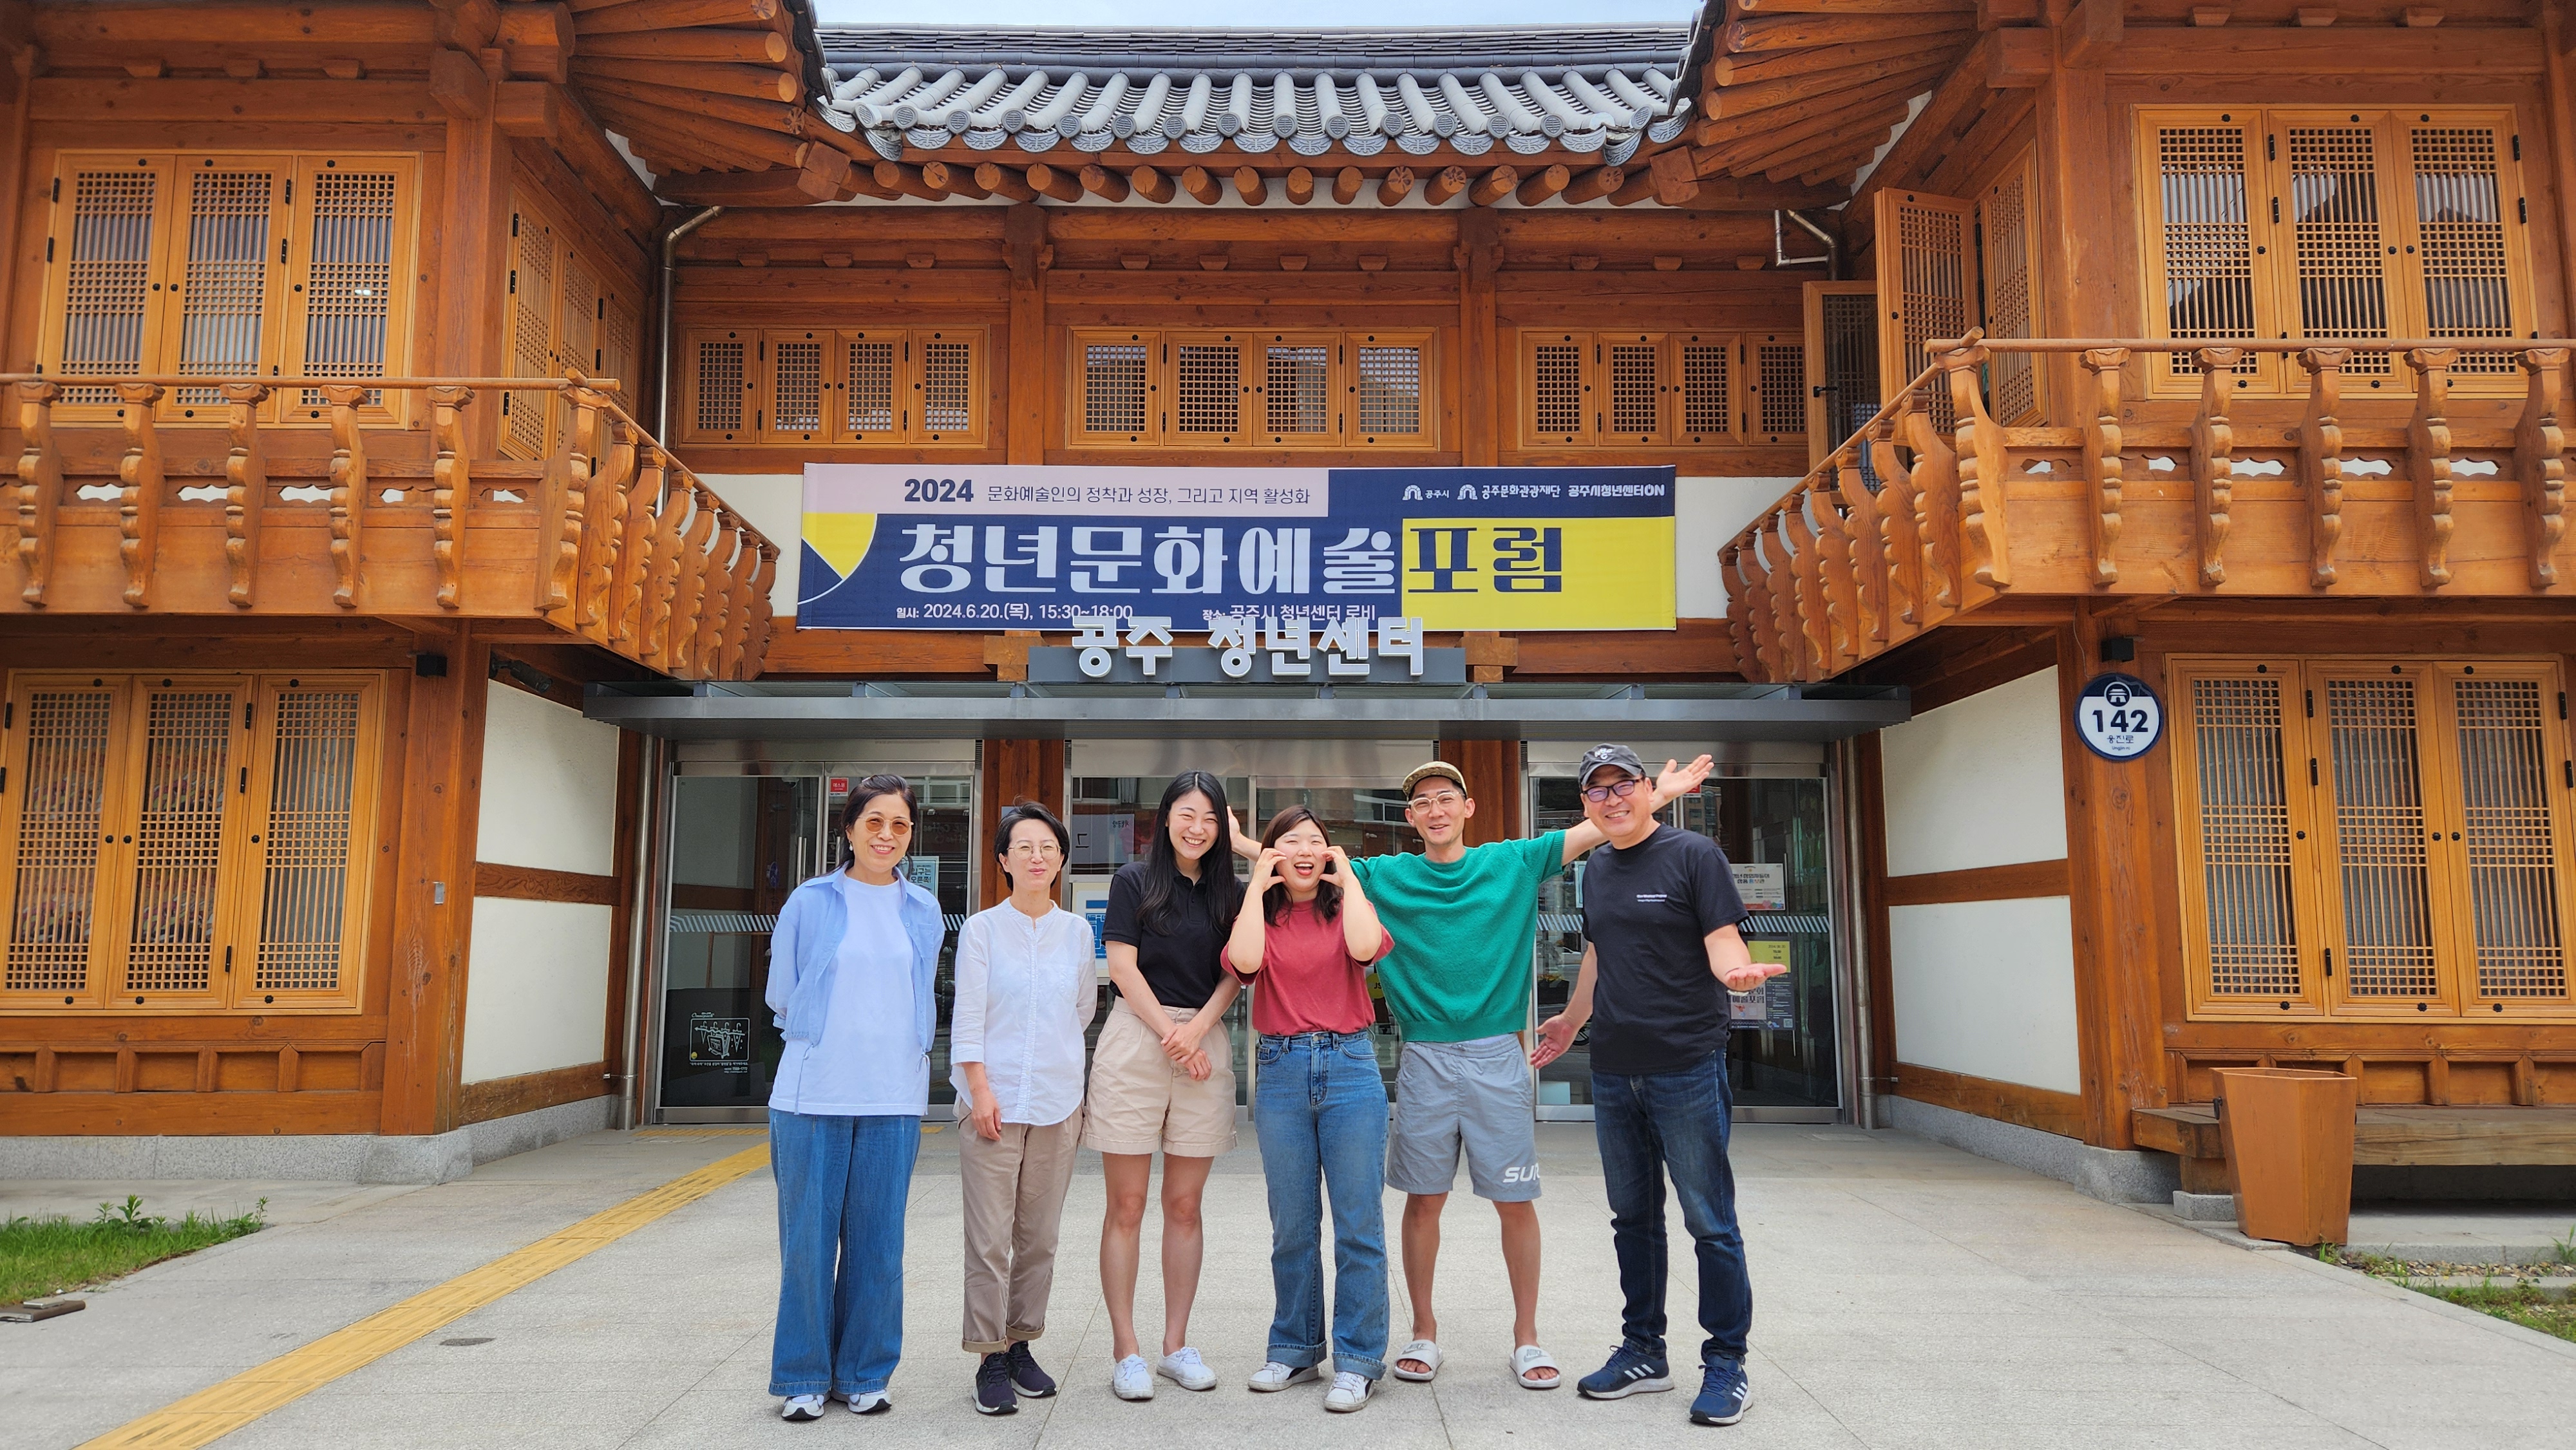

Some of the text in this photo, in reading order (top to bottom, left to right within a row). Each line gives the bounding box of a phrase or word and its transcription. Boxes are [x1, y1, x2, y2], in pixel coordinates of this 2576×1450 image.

[904, 478, 1311, 504] 2024 문화예술인의 정착과 성장, 그리고 지역 활성화
[1425, 489, 1450, 498] 공주시
[1481, 485, 1561, 499] 공주문화관광재단
[896, 602, 1133, 620] 일시: 2024.6.20.(목), 15:30~18:00
[1229, 604, 1275, 620] 공주시
[1280, 604, 1341, 621] 청년센터
[1346, 605, 1376, 621] 로비
[1072, 616, 1424, 678] 공주 청년센터
[2092, 710, 2149, 733] 142
[2107, 735, 2134, 744] 웅진로
